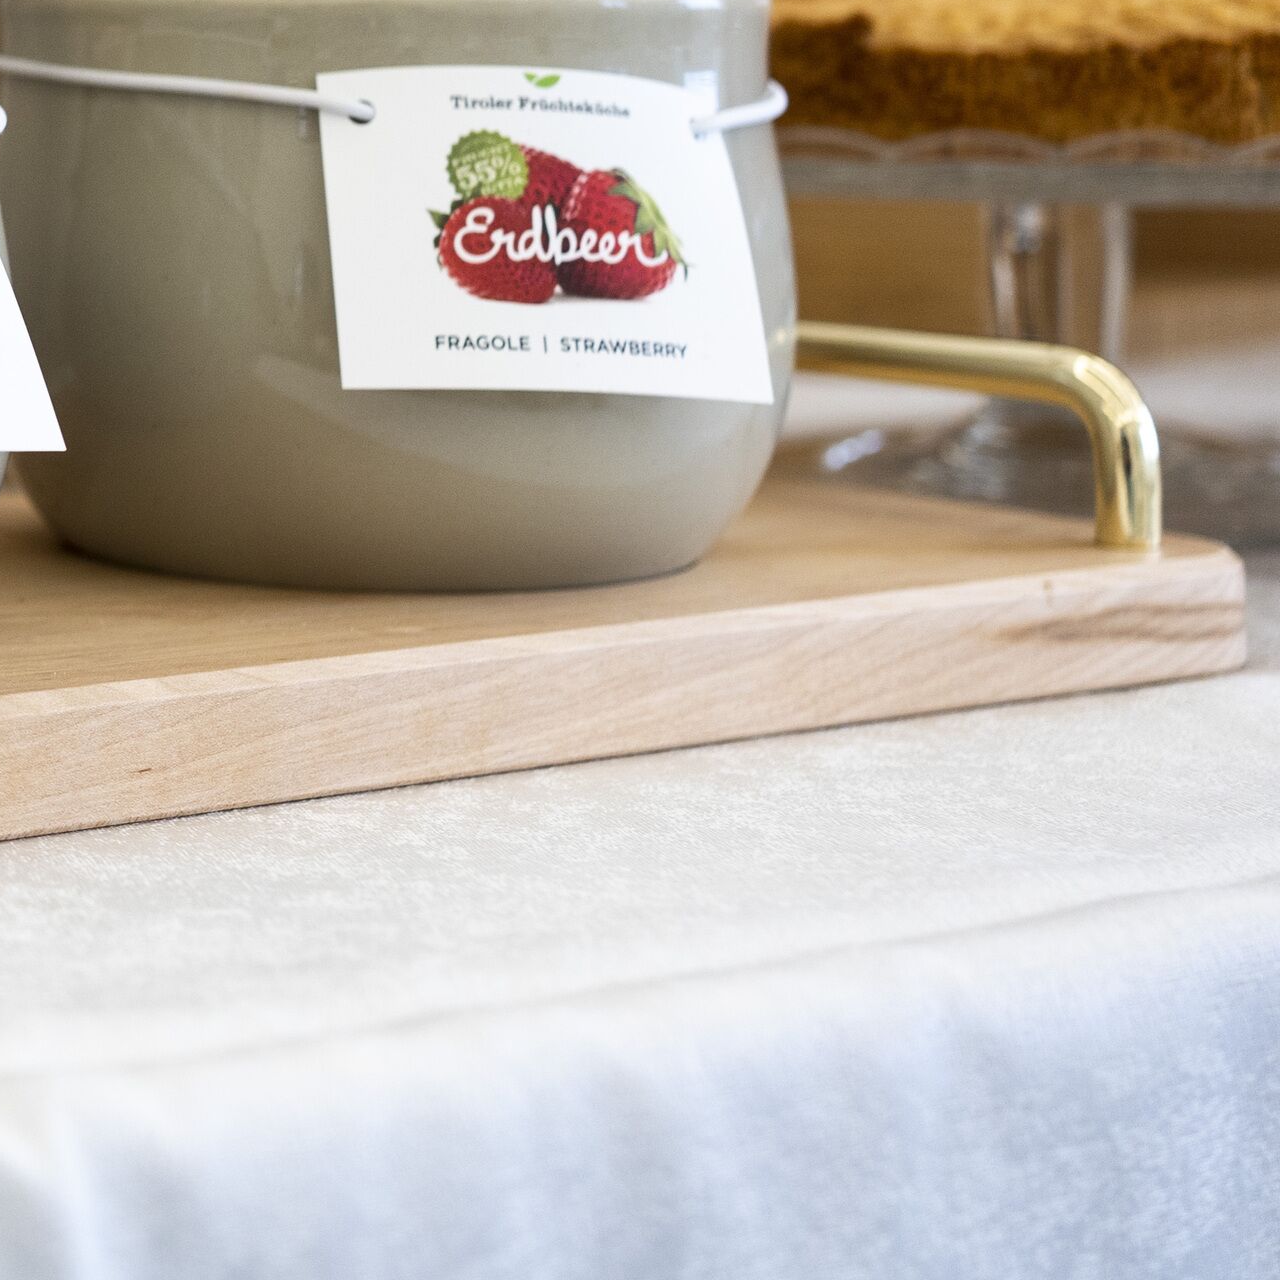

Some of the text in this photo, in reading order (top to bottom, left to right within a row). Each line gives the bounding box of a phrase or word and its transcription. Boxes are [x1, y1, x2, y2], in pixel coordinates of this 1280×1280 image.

[450, 95, 513, 110] Tiroler
[454, 204, 669, 266] Erdbeer
[434, 334, 688, 359] FRAGOLE STRAWBERRY
